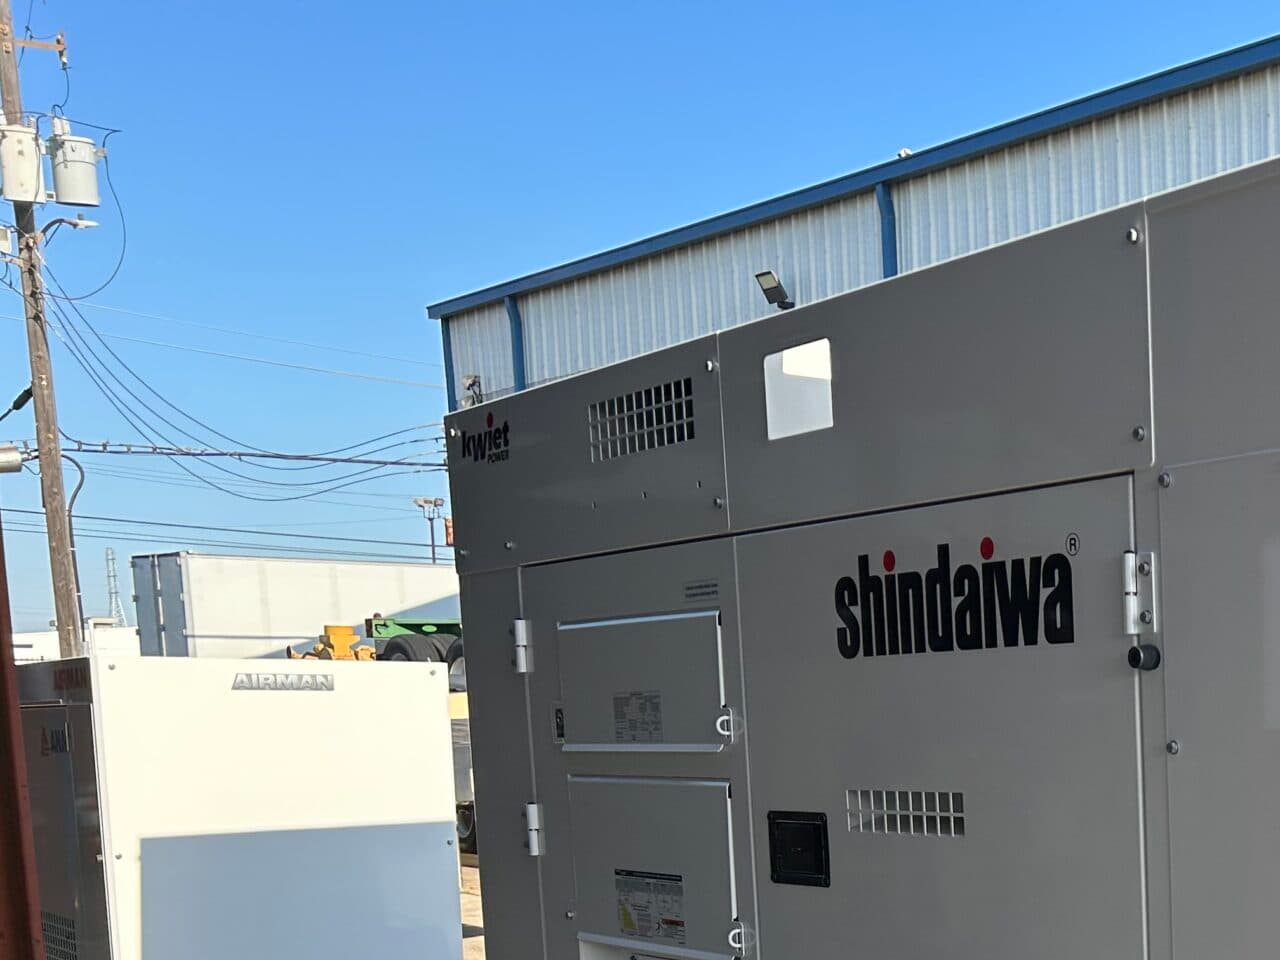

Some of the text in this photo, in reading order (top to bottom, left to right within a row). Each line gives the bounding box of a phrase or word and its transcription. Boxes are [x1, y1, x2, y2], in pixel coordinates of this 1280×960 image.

[461, 412, 510, 462] kwiet
[834, 536, 1075, 659] shindaiwa
[231, 673, 335, 690] AIRMAN
